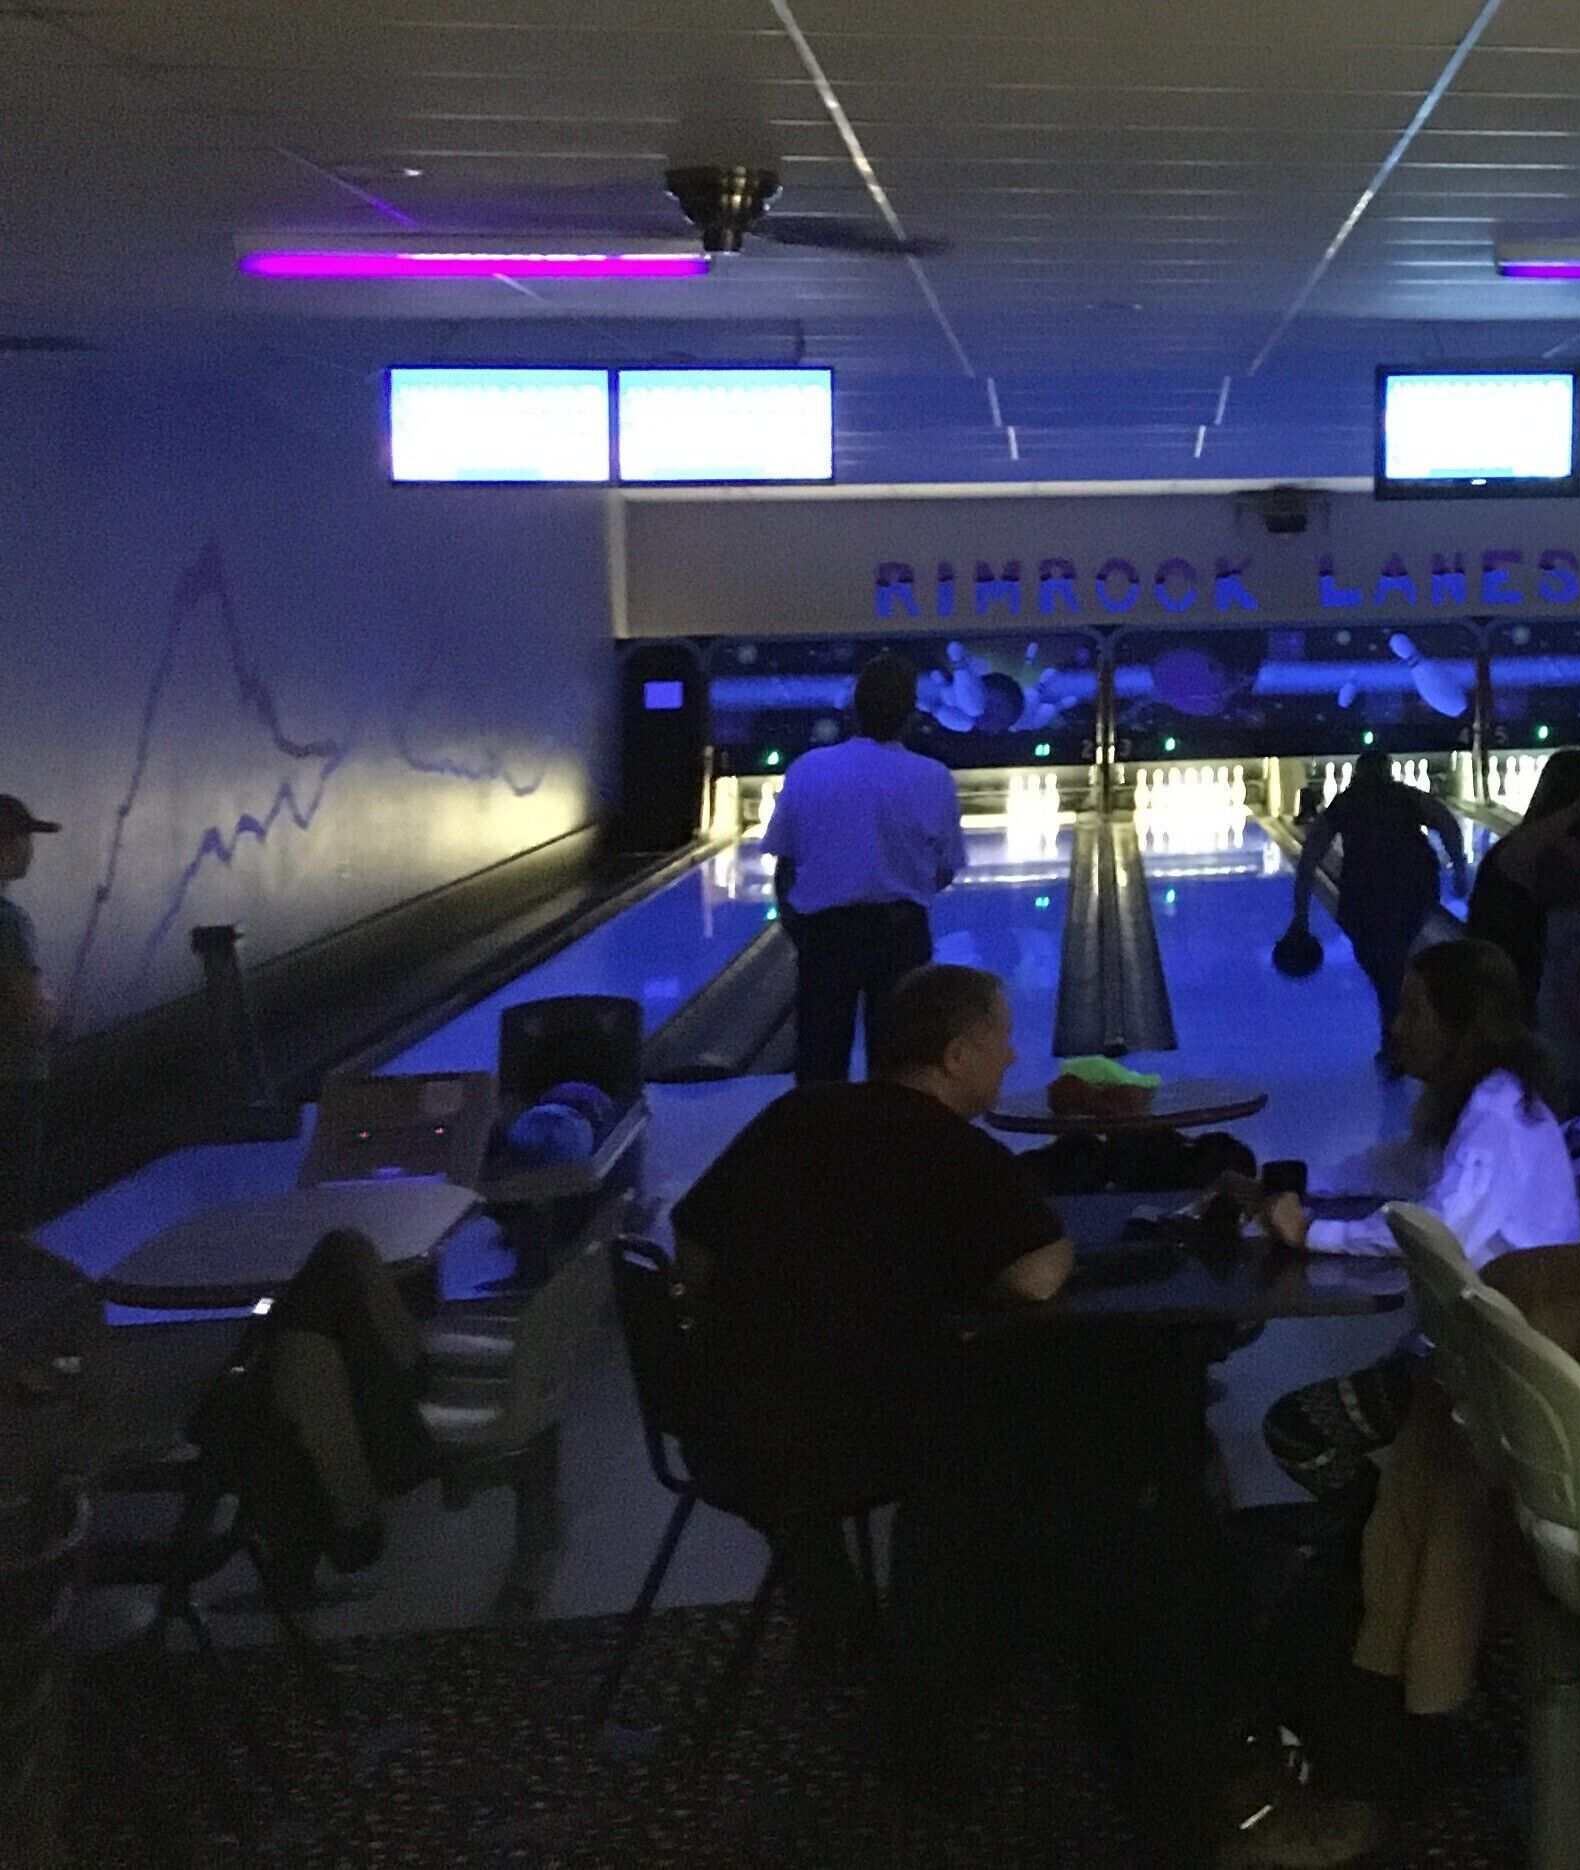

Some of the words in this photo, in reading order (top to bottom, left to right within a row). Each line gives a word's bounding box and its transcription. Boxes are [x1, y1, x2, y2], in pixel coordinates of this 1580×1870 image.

[873, 556, 1260, 619] RIMROCK
[1081, 738, 1094, 759] 2
[1119, 738, 1133, 759] 3
